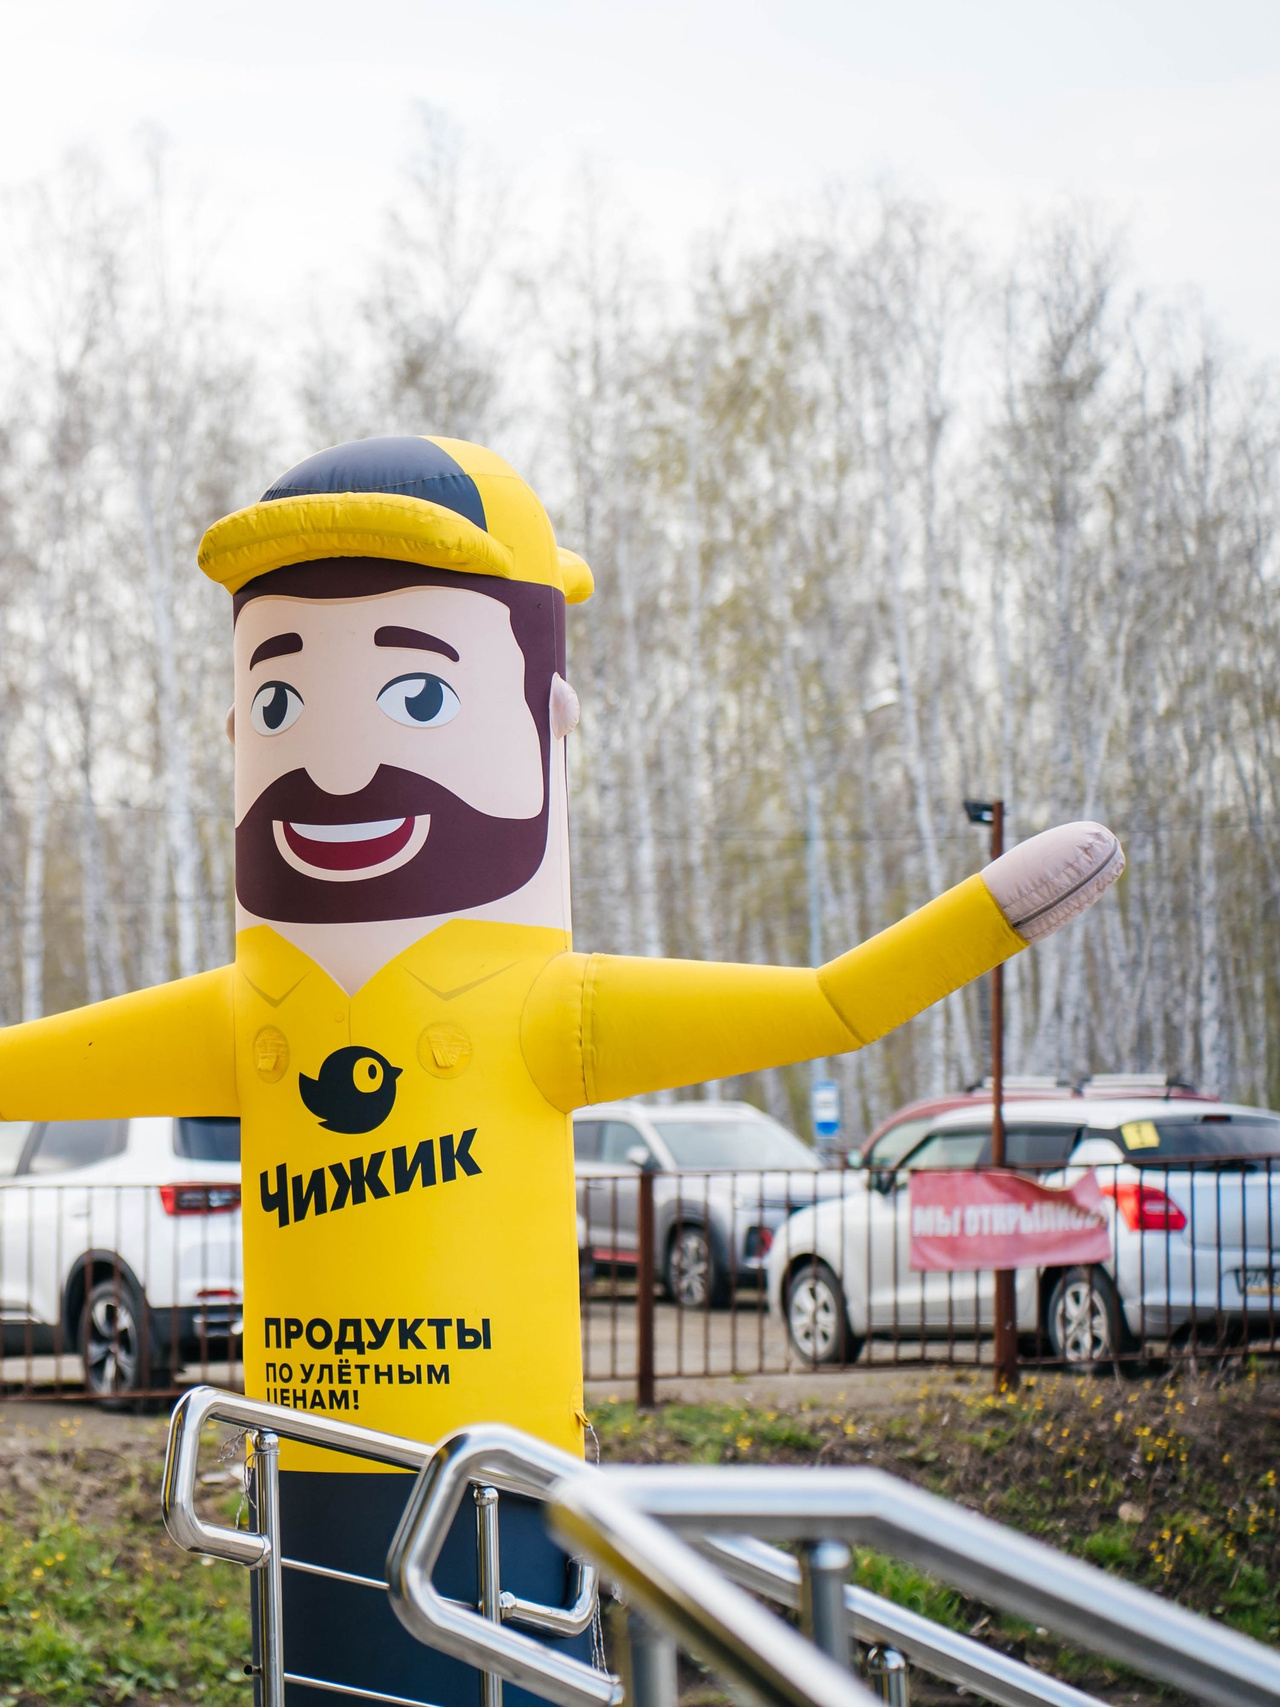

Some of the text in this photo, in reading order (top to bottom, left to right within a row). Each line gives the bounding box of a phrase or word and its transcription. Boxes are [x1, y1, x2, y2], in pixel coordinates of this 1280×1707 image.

[264, 1317, 492, 1355] ПРОДУКТЫ
[265, 1359, 450, 1385] ПО УЛЁТНЫМ
